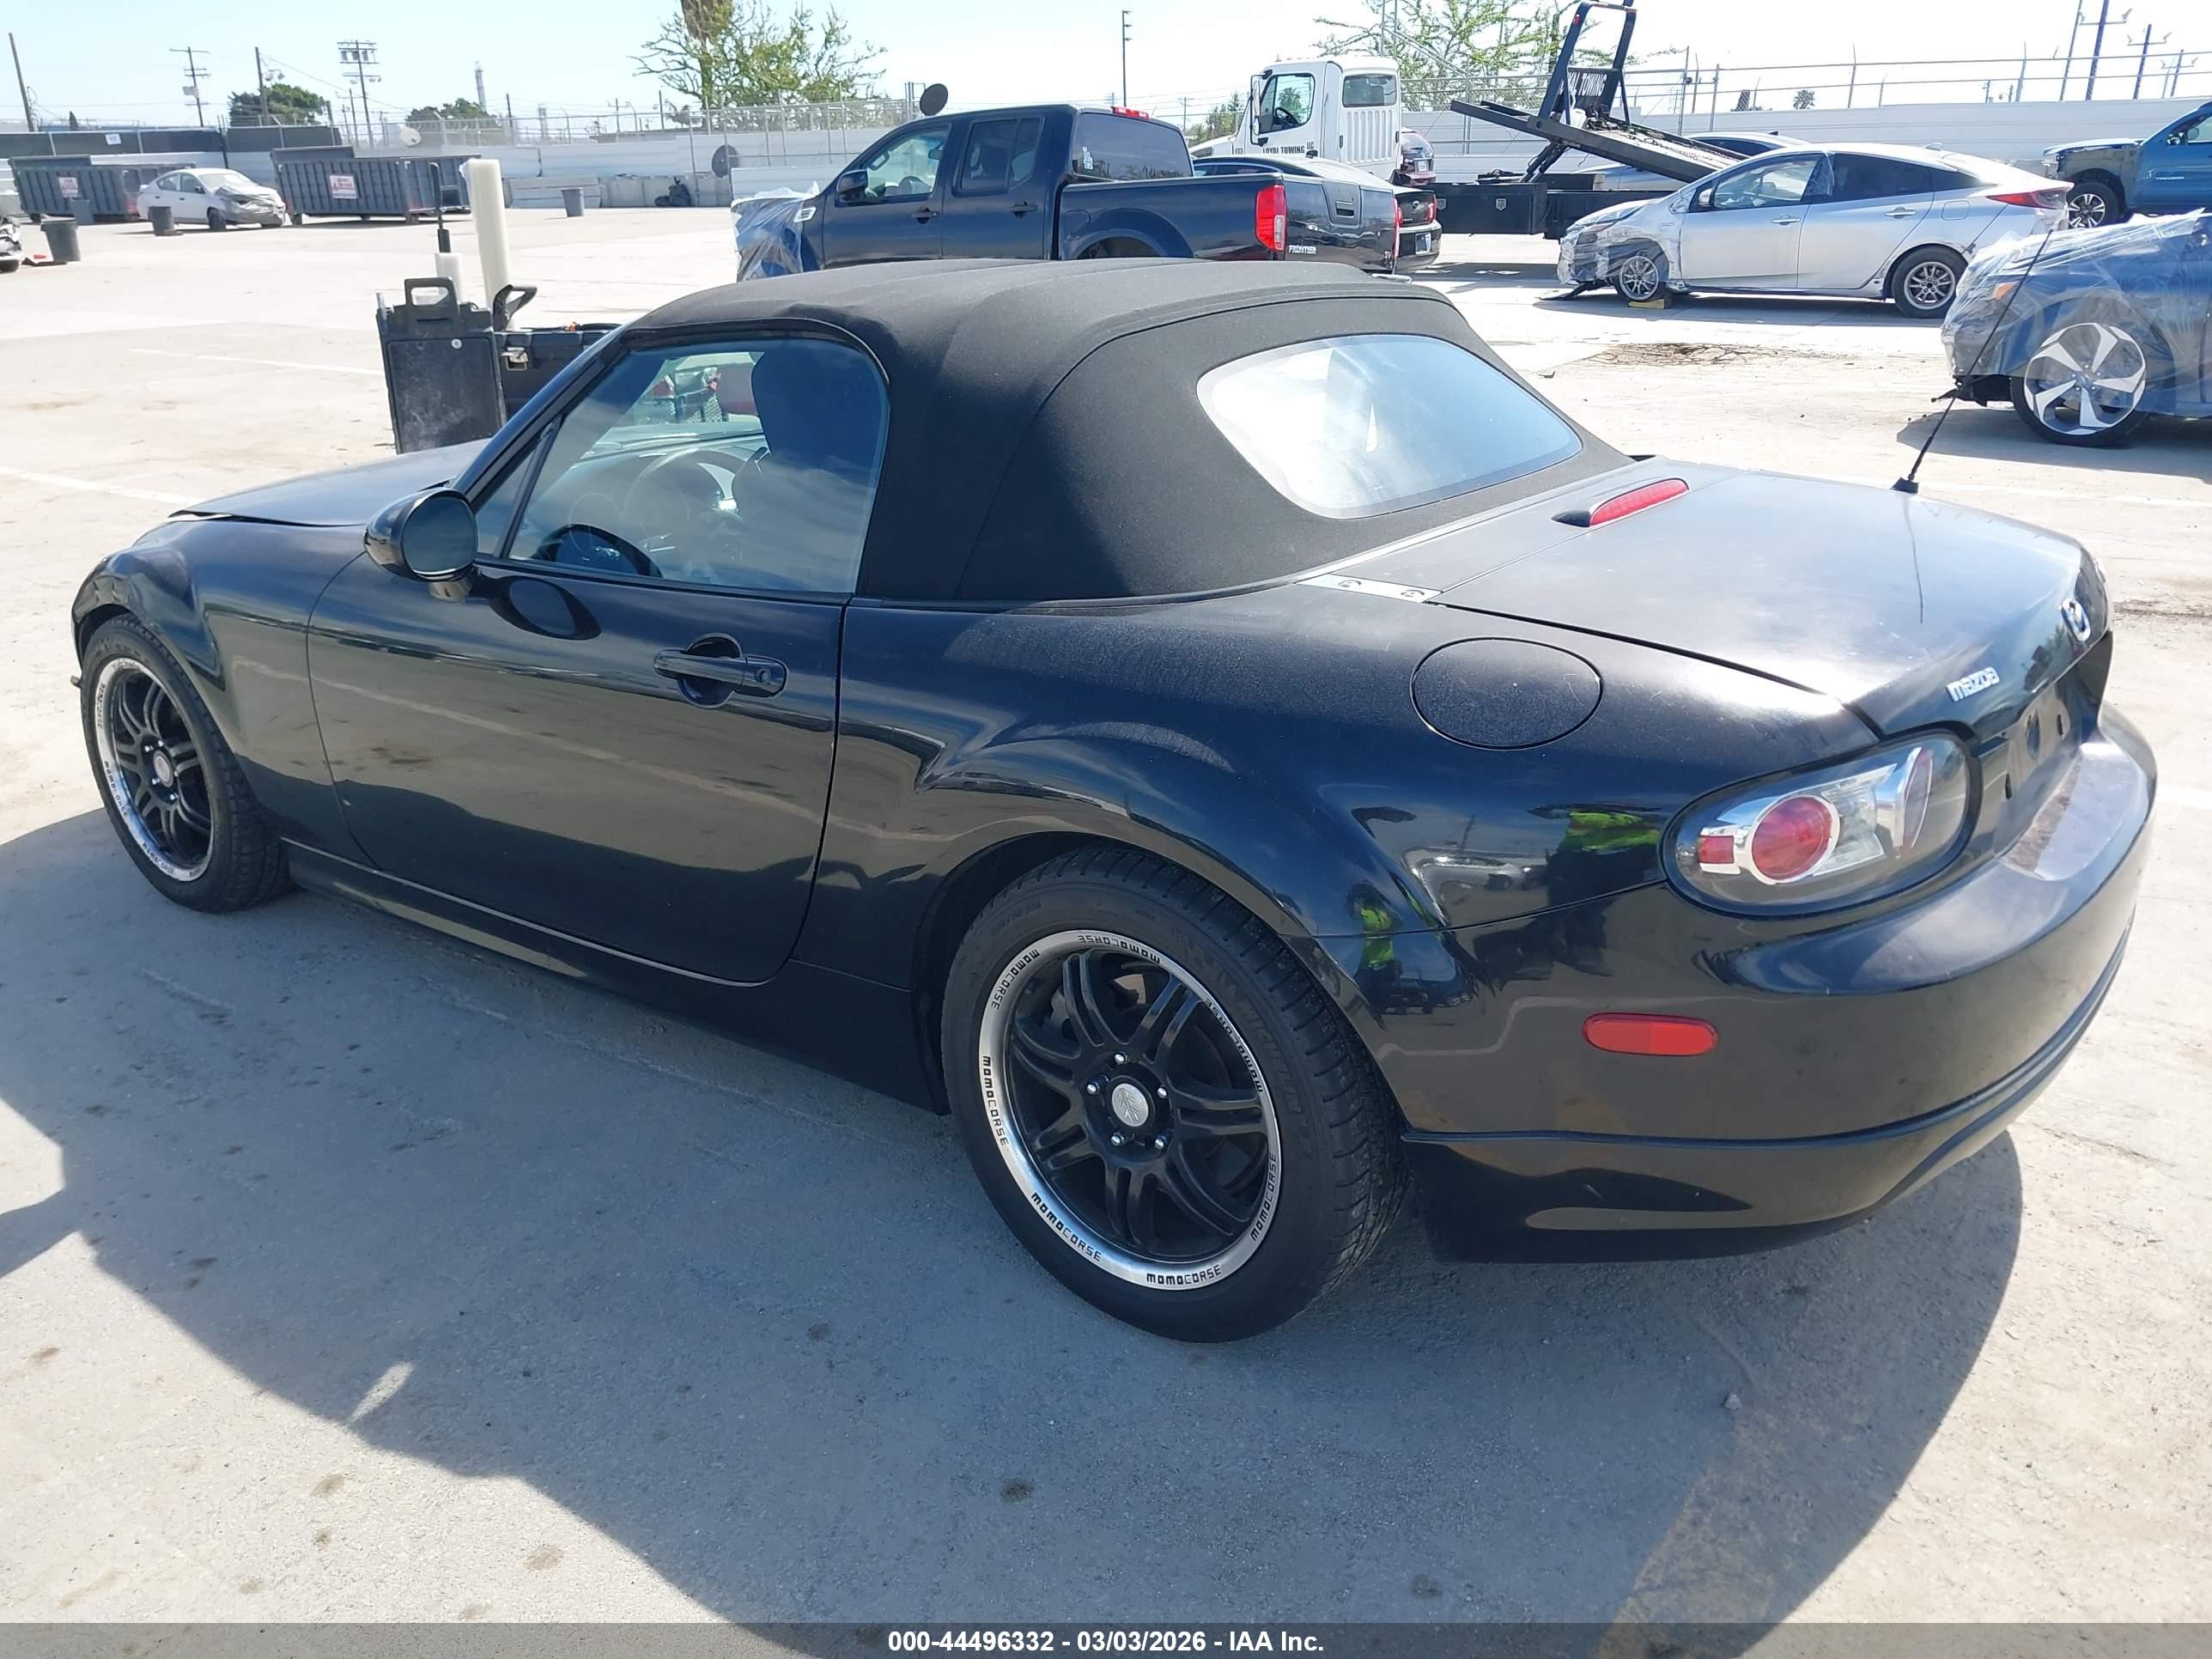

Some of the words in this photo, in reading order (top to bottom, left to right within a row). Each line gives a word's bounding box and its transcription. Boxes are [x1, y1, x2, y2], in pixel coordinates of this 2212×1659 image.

[1578, 72, 1607, 97] TOWING
[1280, 146, 1305, 155] TOWING
[1306, 141, 1315, 149] LLC
[1288, 245, 1317, 255] FRONTIER
